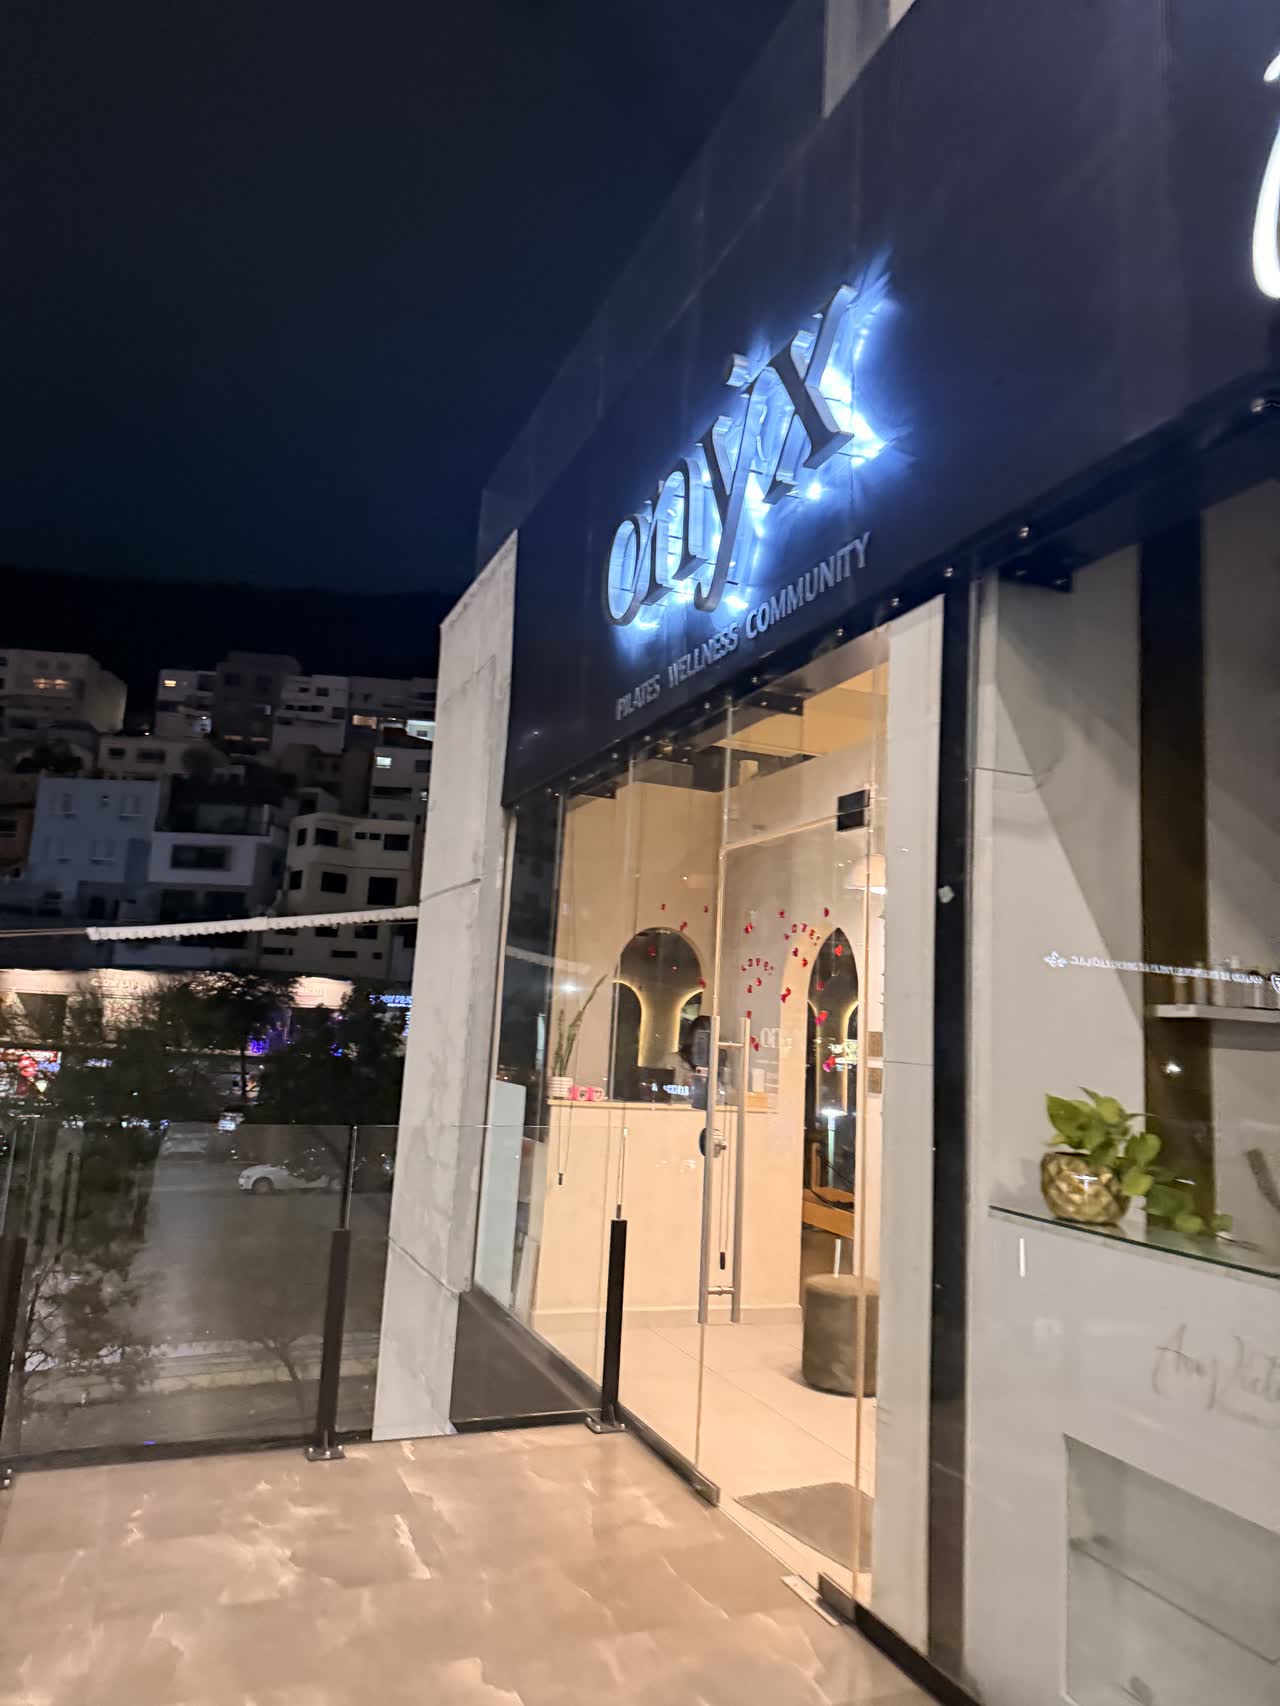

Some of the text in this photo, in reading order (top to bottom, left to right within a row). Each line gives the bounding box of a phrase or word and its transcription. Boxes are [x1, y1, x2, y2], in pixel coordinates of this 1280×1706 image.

[607, 284, 856, 626] onyx
[615, 531, 872, 721] PILATES WELLNESS COMMUNITY
